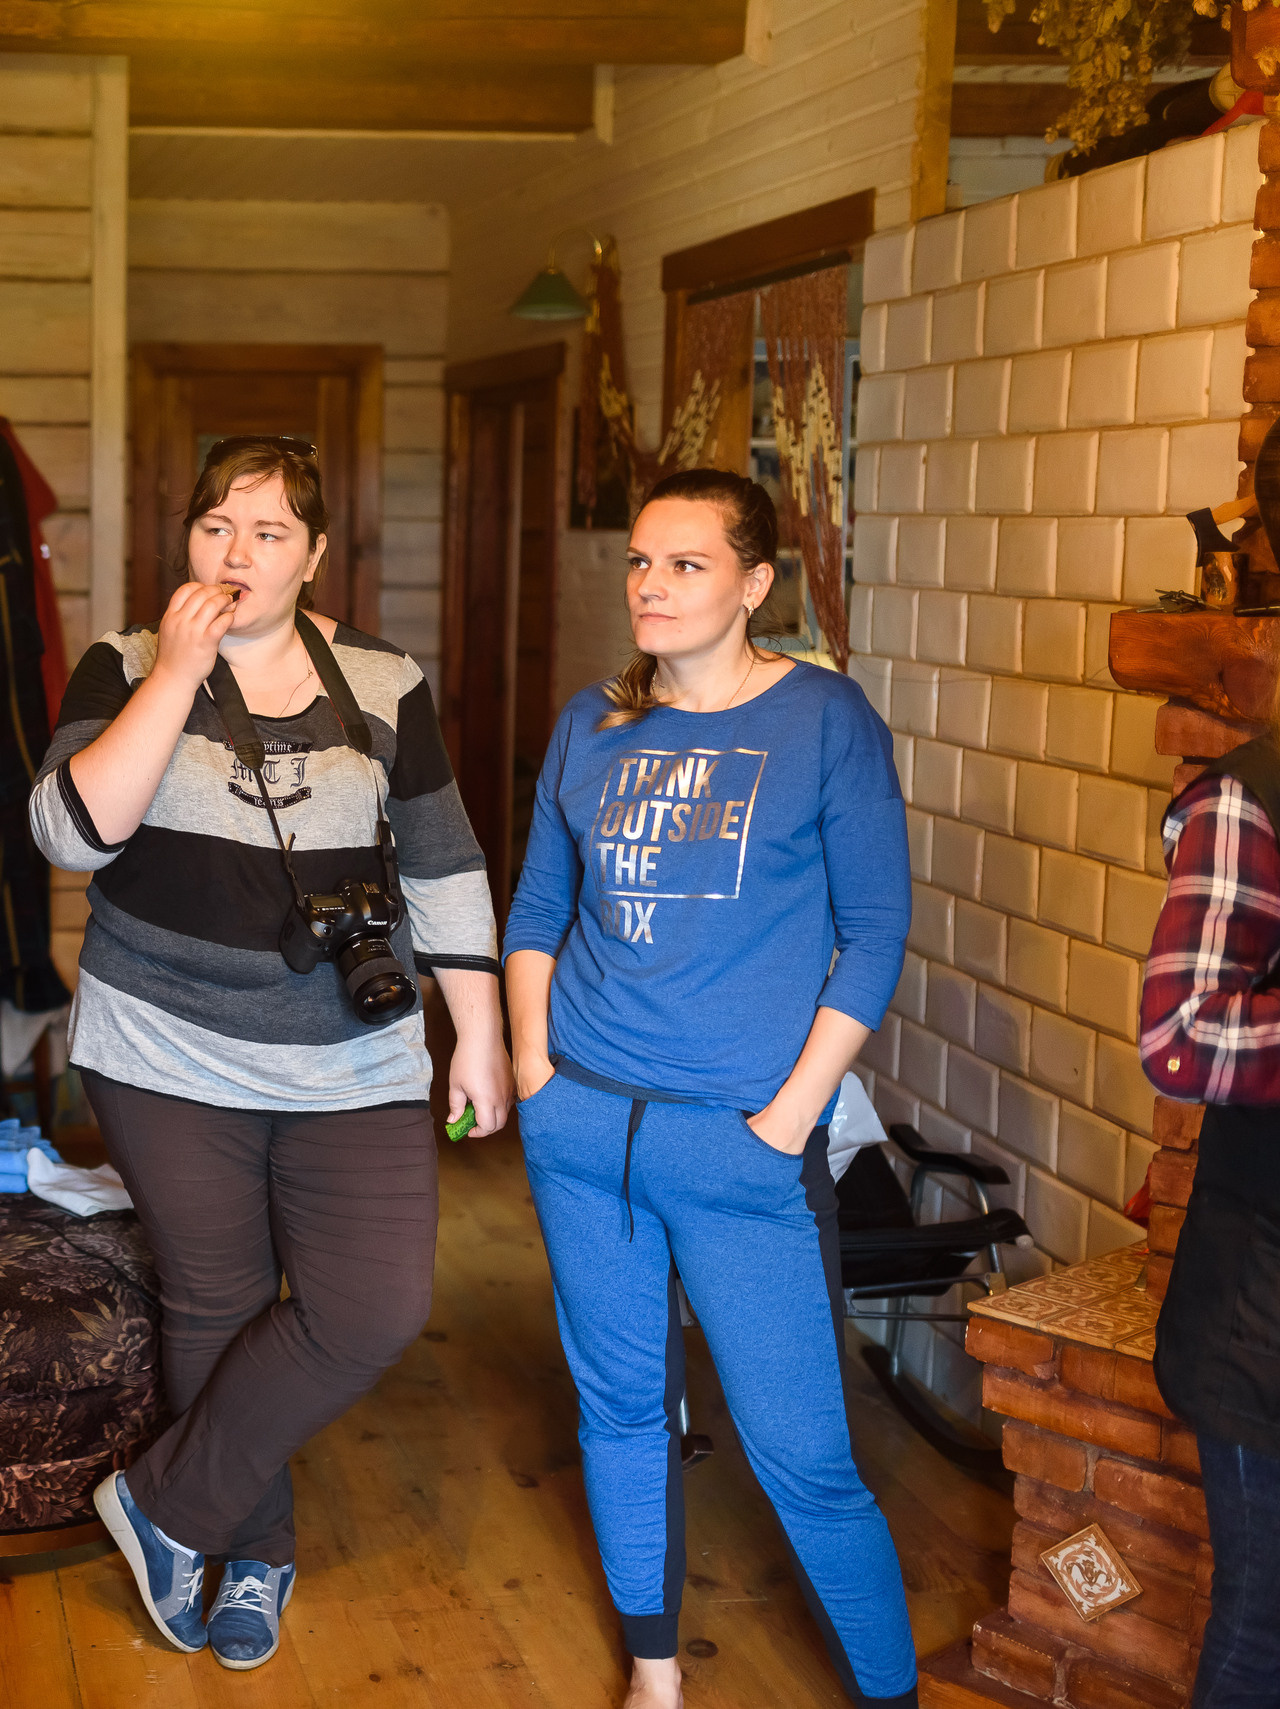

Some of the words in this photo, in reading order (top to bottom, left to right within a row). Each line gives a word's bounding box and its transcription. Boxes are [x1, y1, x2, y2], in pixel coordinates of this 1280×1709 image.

[617, 757, 720, 799] THINK
[599, 799, 746, 843] OUTSIDE
[595, 841, 662, 888] THE
